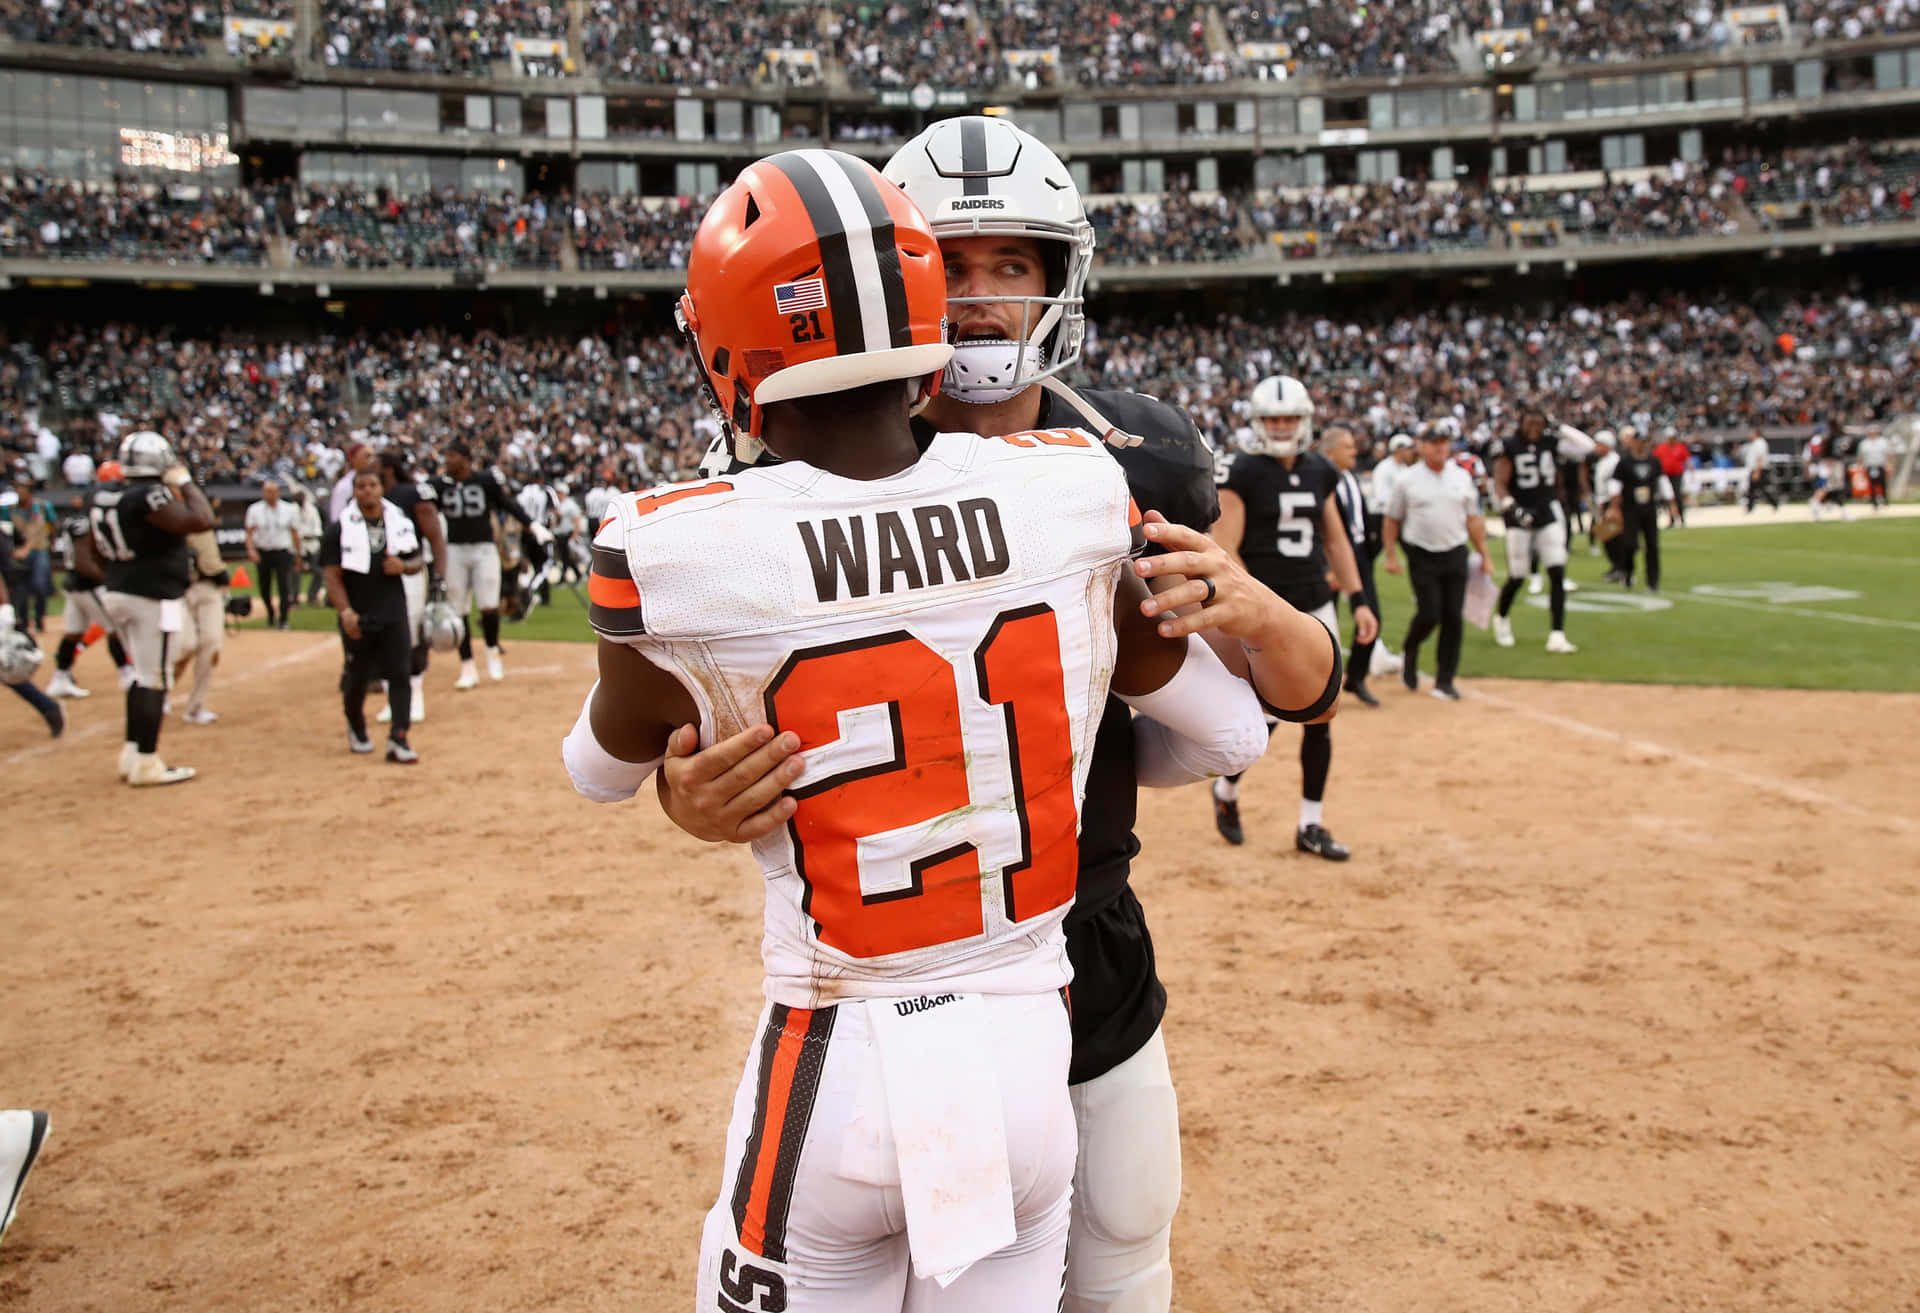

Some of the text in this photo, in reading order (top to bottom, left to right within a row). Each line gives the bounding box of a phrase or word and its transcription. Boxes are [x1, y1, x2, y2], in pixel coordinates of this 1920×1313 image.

[951, 199, 1005, 211] RAIDERS
[790, 311, 825, 343] 21
[1514, 450, 1556, 488] 54
[442, 484, 486, 518] 99
[1277, 492, 1316, 557] 5
[797, 497, 1010, 602] WARD
[763, 601, 1079, 959] 21
[893, 993, 957, 1017] Wilson
